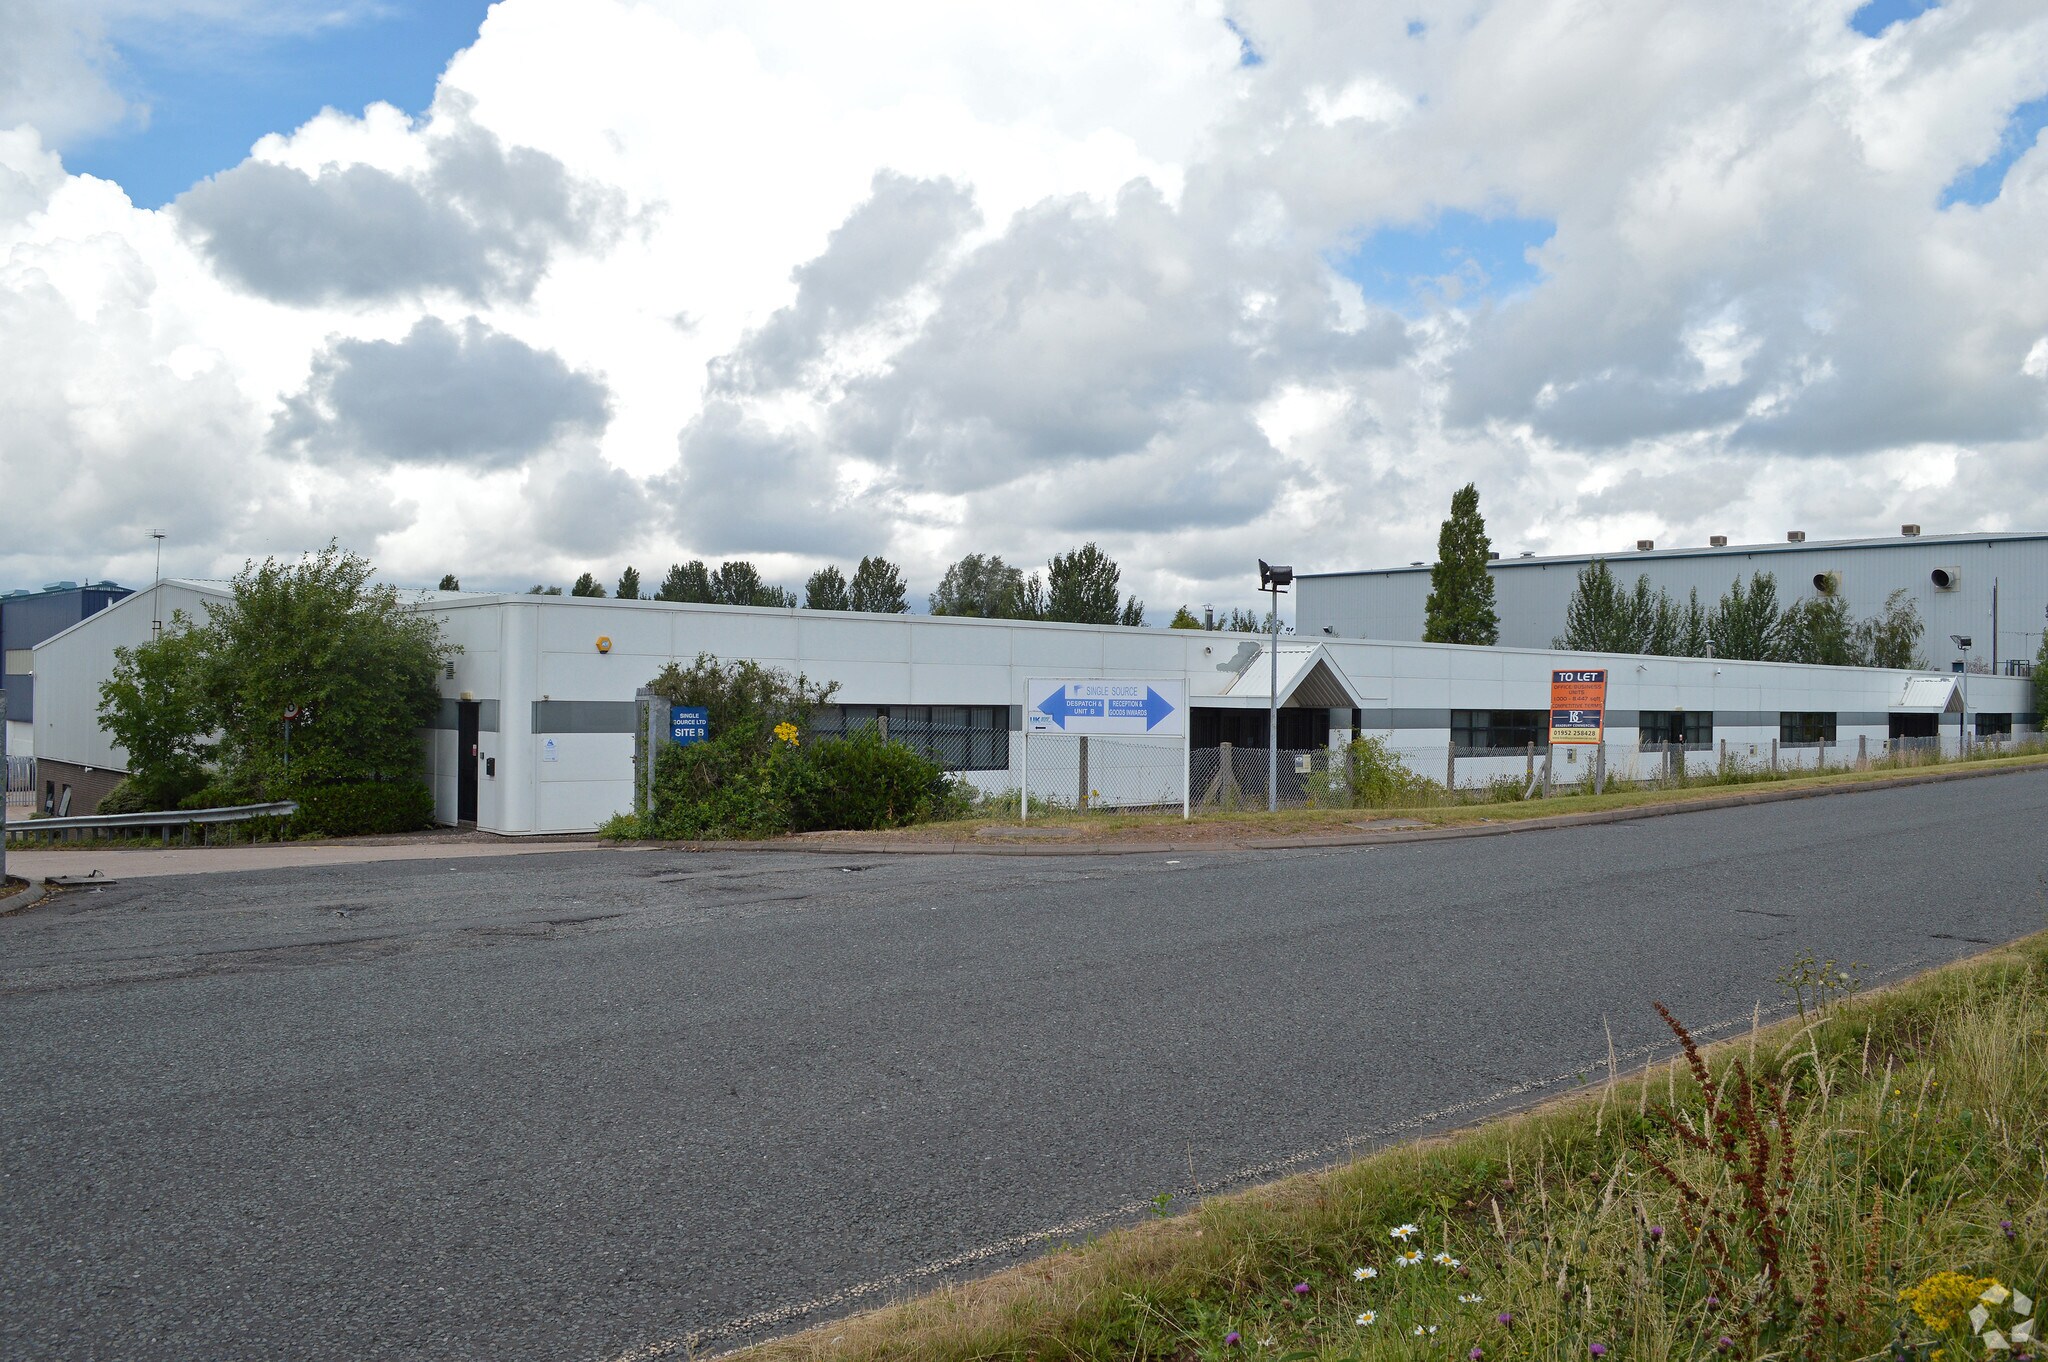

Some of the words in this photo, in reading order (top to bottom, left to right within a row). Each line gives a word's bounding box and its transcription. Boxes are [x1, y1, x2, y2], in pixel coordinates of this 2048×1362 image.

[1559, 672, 1573, 682] TO
[1577, 672, 1598, 682] LET
[1086, 686, 1109, 696] SINGLE
[1111, 686, 1138, 696] SOURCE
[675, 728, 695, 737] SITE
[697, 728, 704, 737] B
